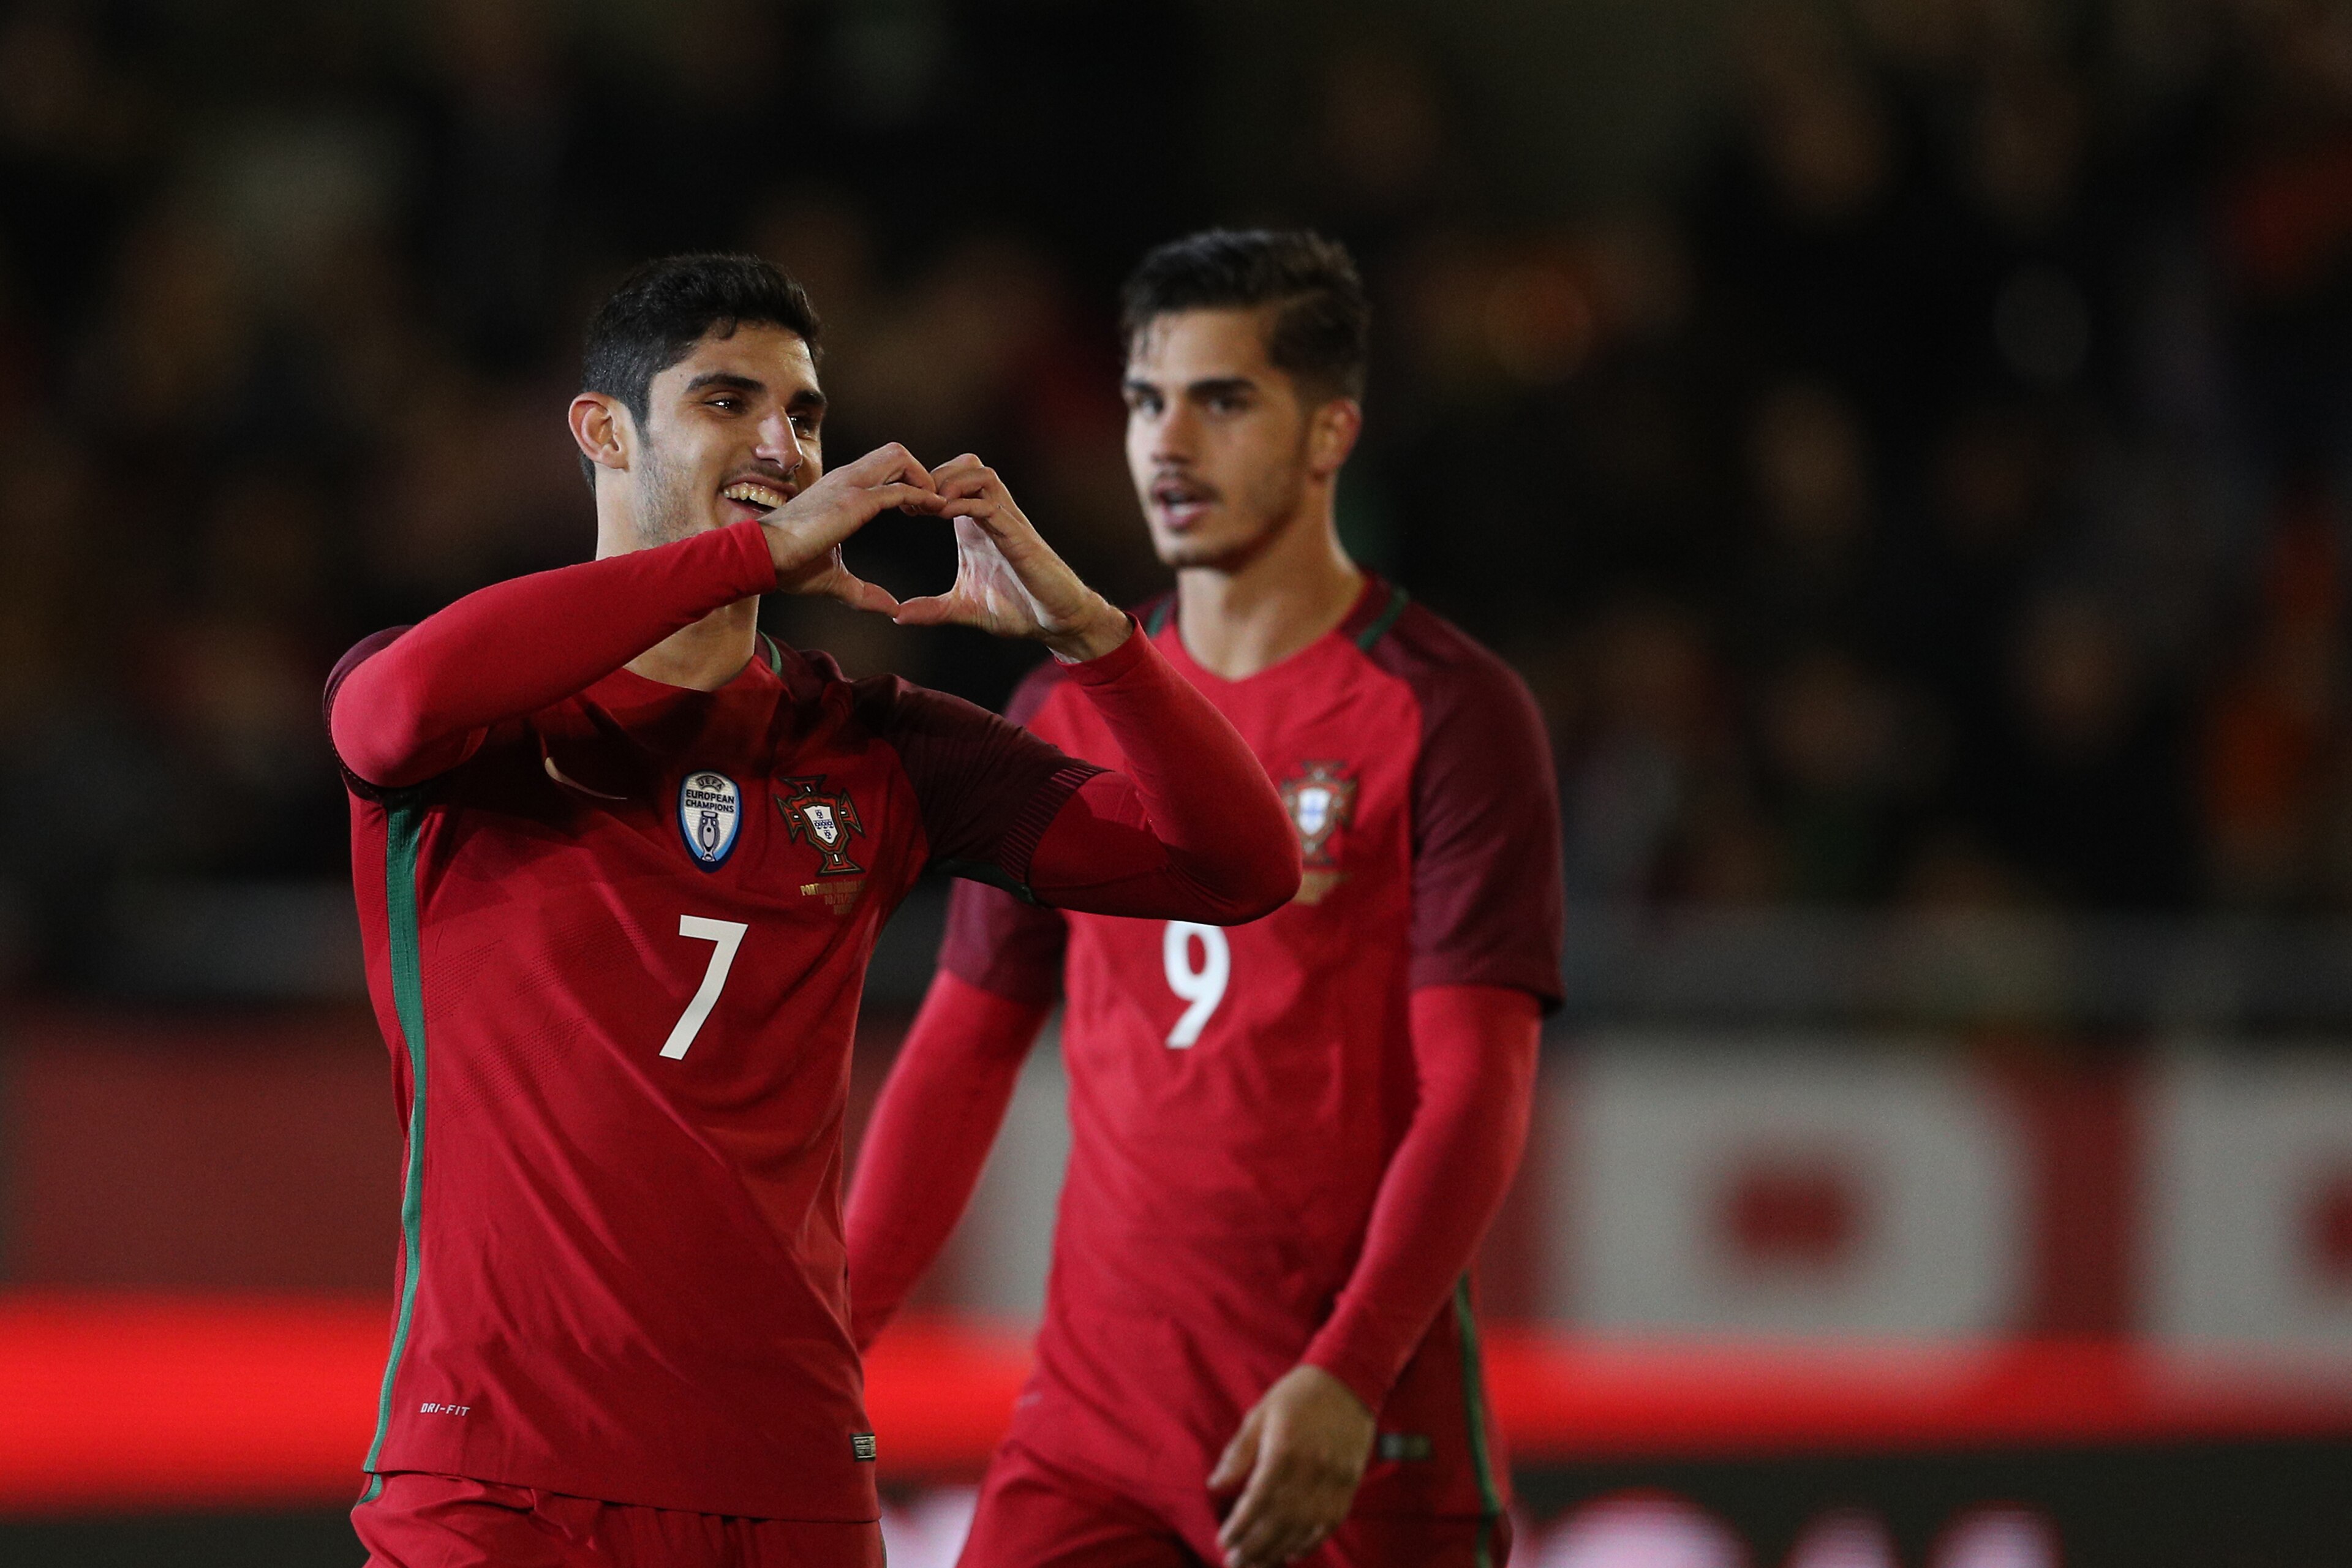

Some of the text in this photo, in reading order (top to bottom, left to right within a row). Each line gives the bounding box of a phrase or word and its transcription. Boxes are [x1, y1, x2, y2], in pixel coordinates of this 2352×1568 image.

[699, 777, 722, 790] UEFA
[686, 790, 734, 804] EUROPEAN
[685, 799, 734, 813] CHAMPIONS
[659, 914, 748, 1060] 7
[1163, 919, 1231, 1049] 9
[420, 1403, 470, 1416] DRI-FIT
